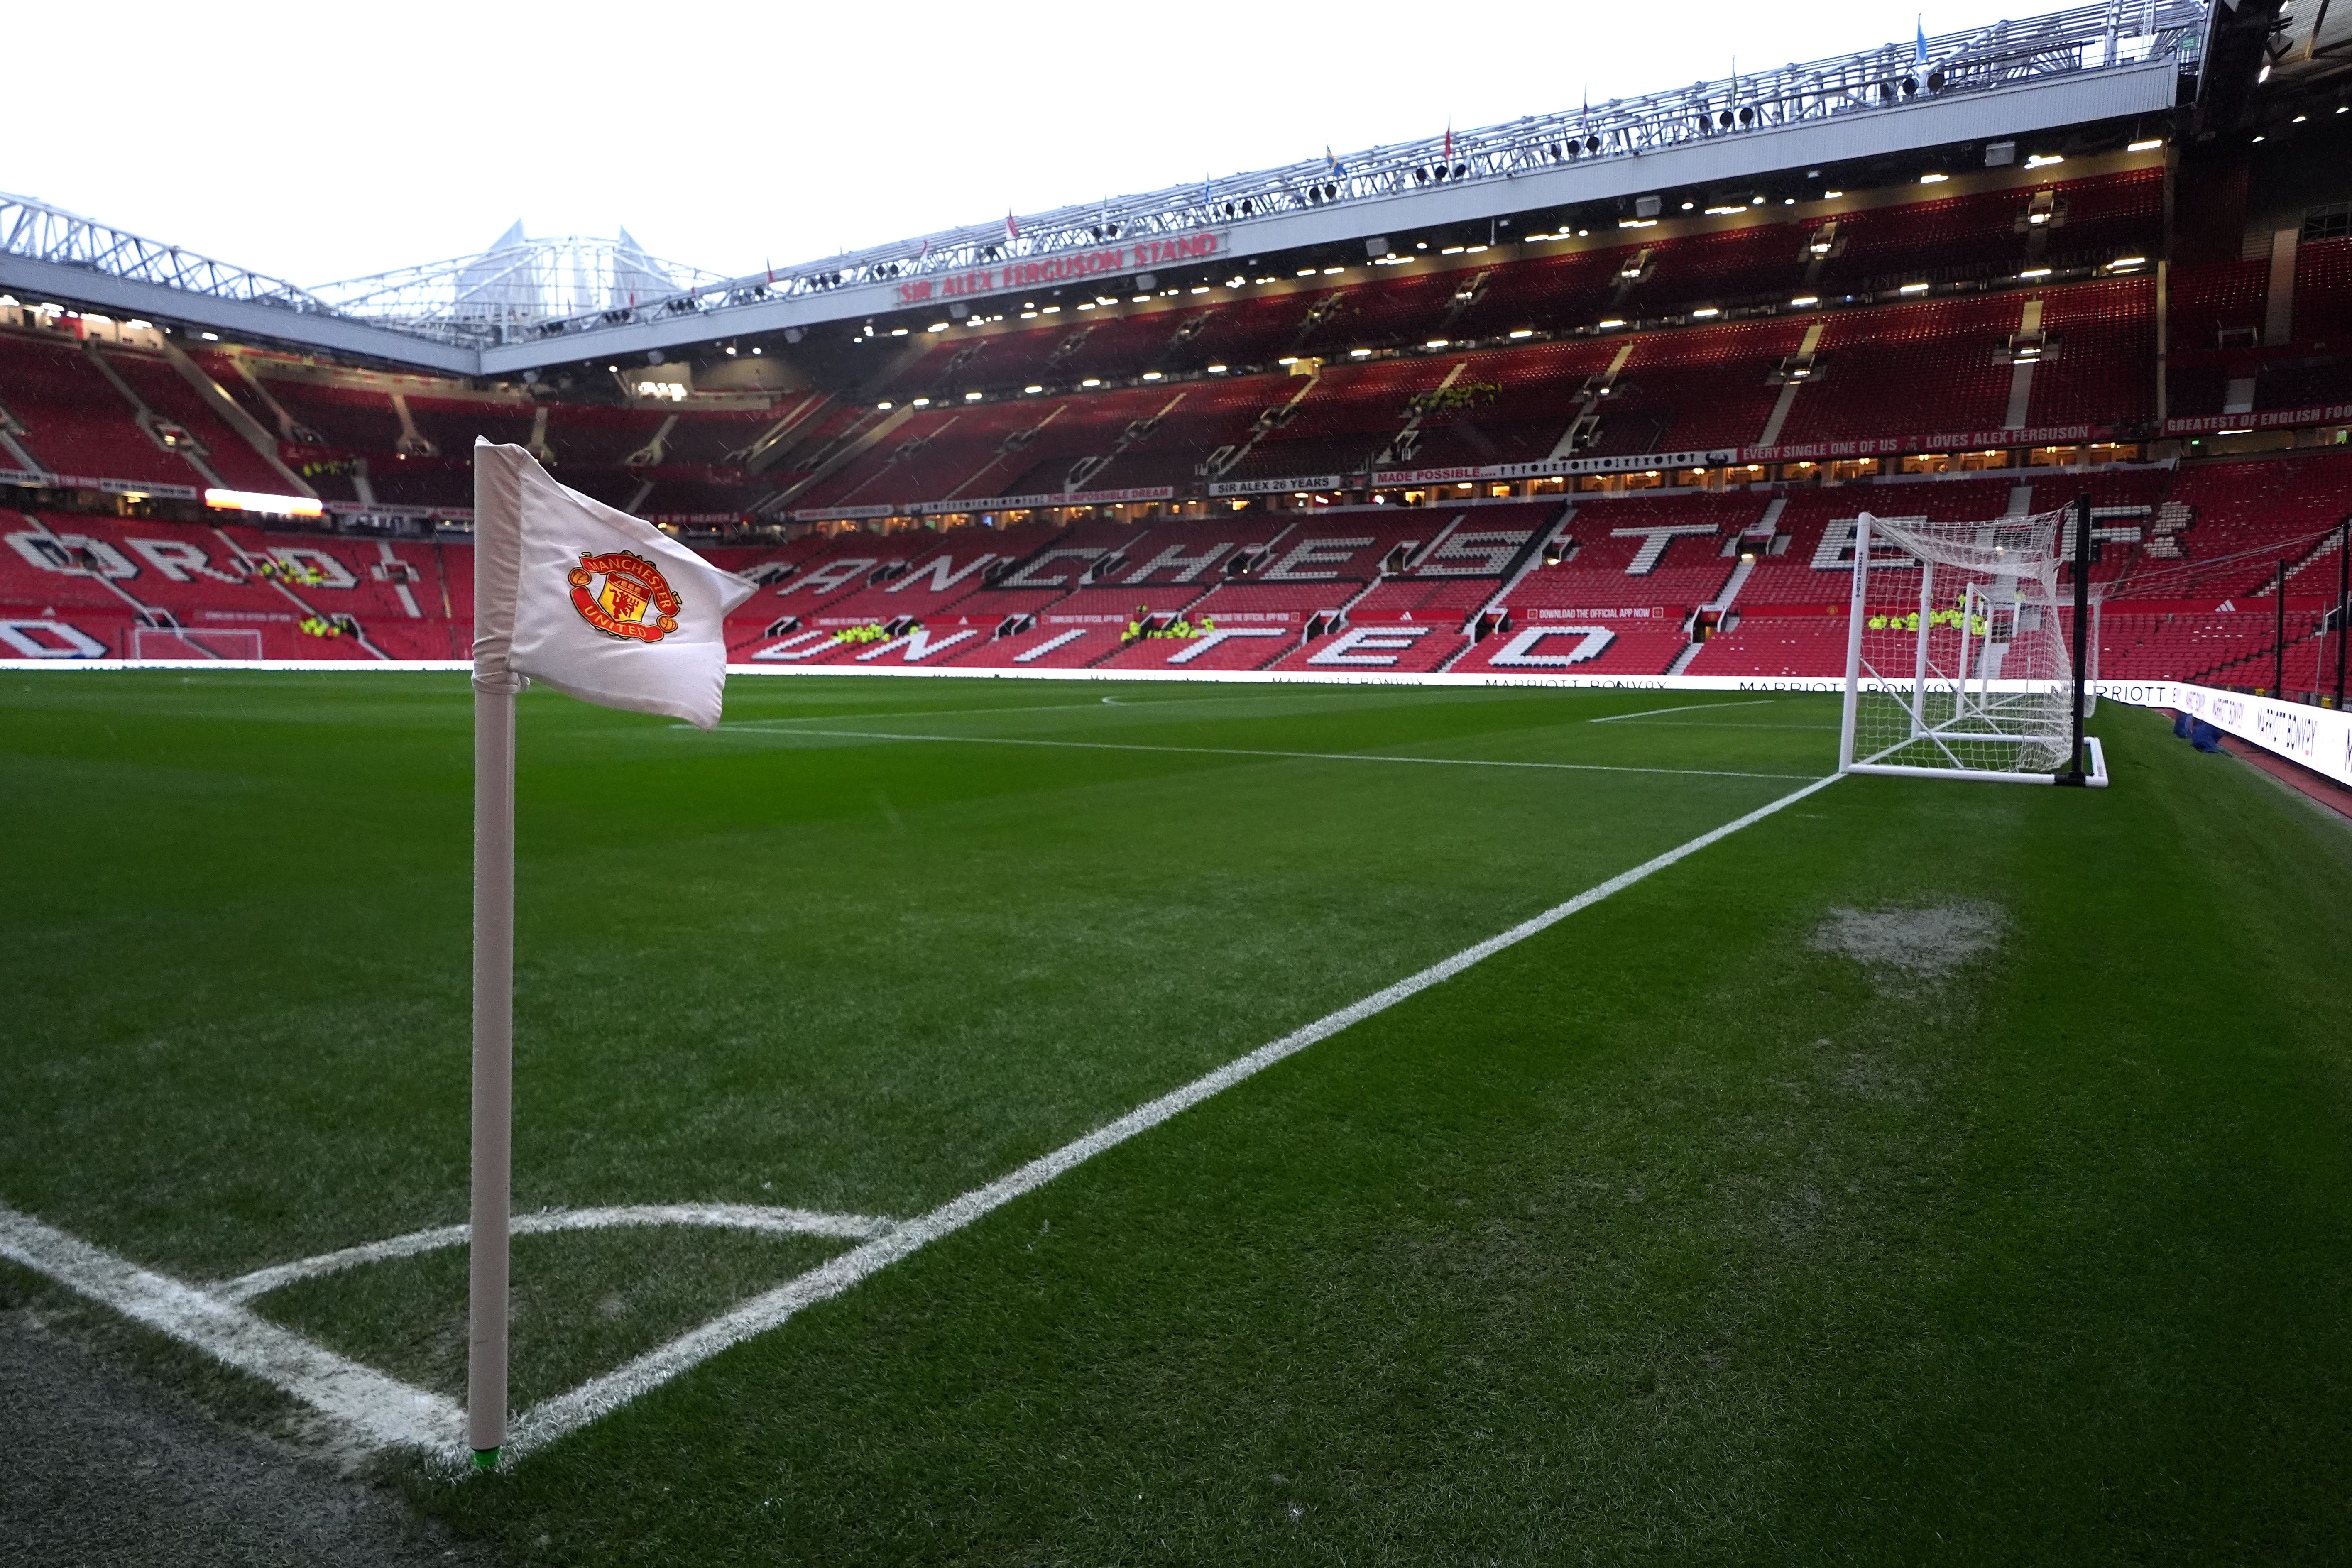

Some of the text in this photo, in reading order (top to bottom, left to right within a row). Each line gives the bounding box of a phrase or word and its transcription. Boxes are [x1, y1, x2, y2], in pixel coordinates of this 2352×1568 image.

[900, 234, 1216, 303] SIR ALEX FERGUSON STAND
[2167, 416, 2236, 431] GREATEST
[2240, 415, 2256, 427] OF
[2260, 409, 2320, 425] ENGLISH
[1926, 426, 2088, 448] LOVES ALEX FERGUSON
[1743, 439, 1897, 460] EVERY SINGLE ONE OF US
[1218, 483, 1236, 494] SIR
[1240, 481, 1269, 492] ALEX
[1290, 477, 1329, 488] YEARS
[1378, 472, 1412, 483] MADE
[1132, 487, 1168, 498] DREAM
[587, 558, 672, 608] MANCHESTER
[585, 605, 647, 638] UNITED
[1539, 608, 1650, 619] DOWNLOAD THE OFFICIAL APP NOW
[751, 626, 1616, 666] UNITED
